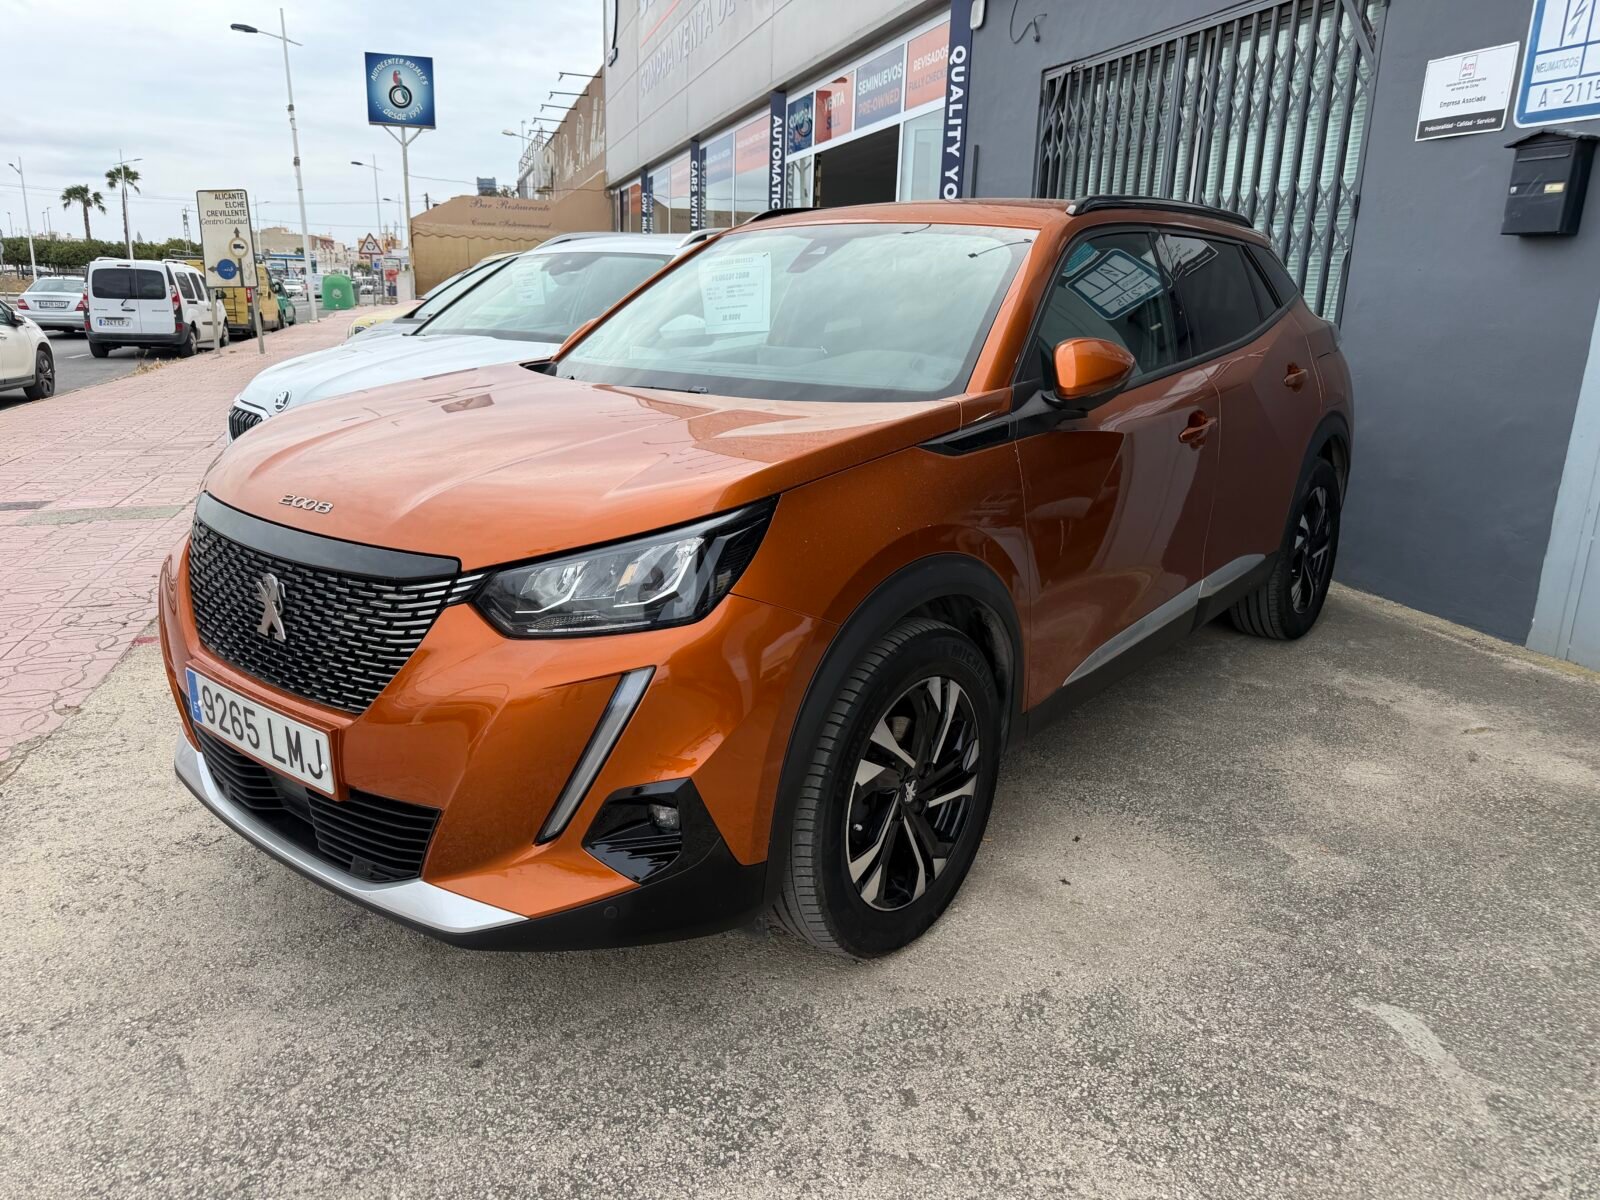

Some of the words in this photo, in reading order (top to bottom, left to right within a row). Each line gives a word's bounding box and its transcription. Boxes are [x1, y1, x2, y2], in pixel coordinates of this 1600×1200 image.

[677, 0, 713, 62] VENTA
[913, 45, 949, 72] REVISADOS
[1535, 56, 1580, 74] NEUMATICOS
[370, 58, 404, 81] AUTOCENTER
[405, 60, 429, 86] ROJALES
[858, 62, 902, 96] SEMINUEVOS
[382, 106, 406, 120] desde
[408, 103, 423, 118] 1997
[825, 91, 845, 112] VENTA
[858, 88, 899, 114] PRE-OWNED
[946, 45, 967, 157] QUALITY
[1440, 100, 1461, 108] Empresa
[1461, 96, 1486, 104] Asociada
[1456, 119, 1473, 127] Calidad
[1476, 117, 1496, 125] Servicio
[771, 116, 783, 209] AUTOMATIC
[214, 192, 244, 200] ALICANTE
[206, 209, 247, 217] CREVILLENTE
[224, 217, 248, 225] Ciudad
[279, 494, 334, 514] 2008
[202, 685, 260, 750] 9265
[267, 717, 323, 780] LMJ
